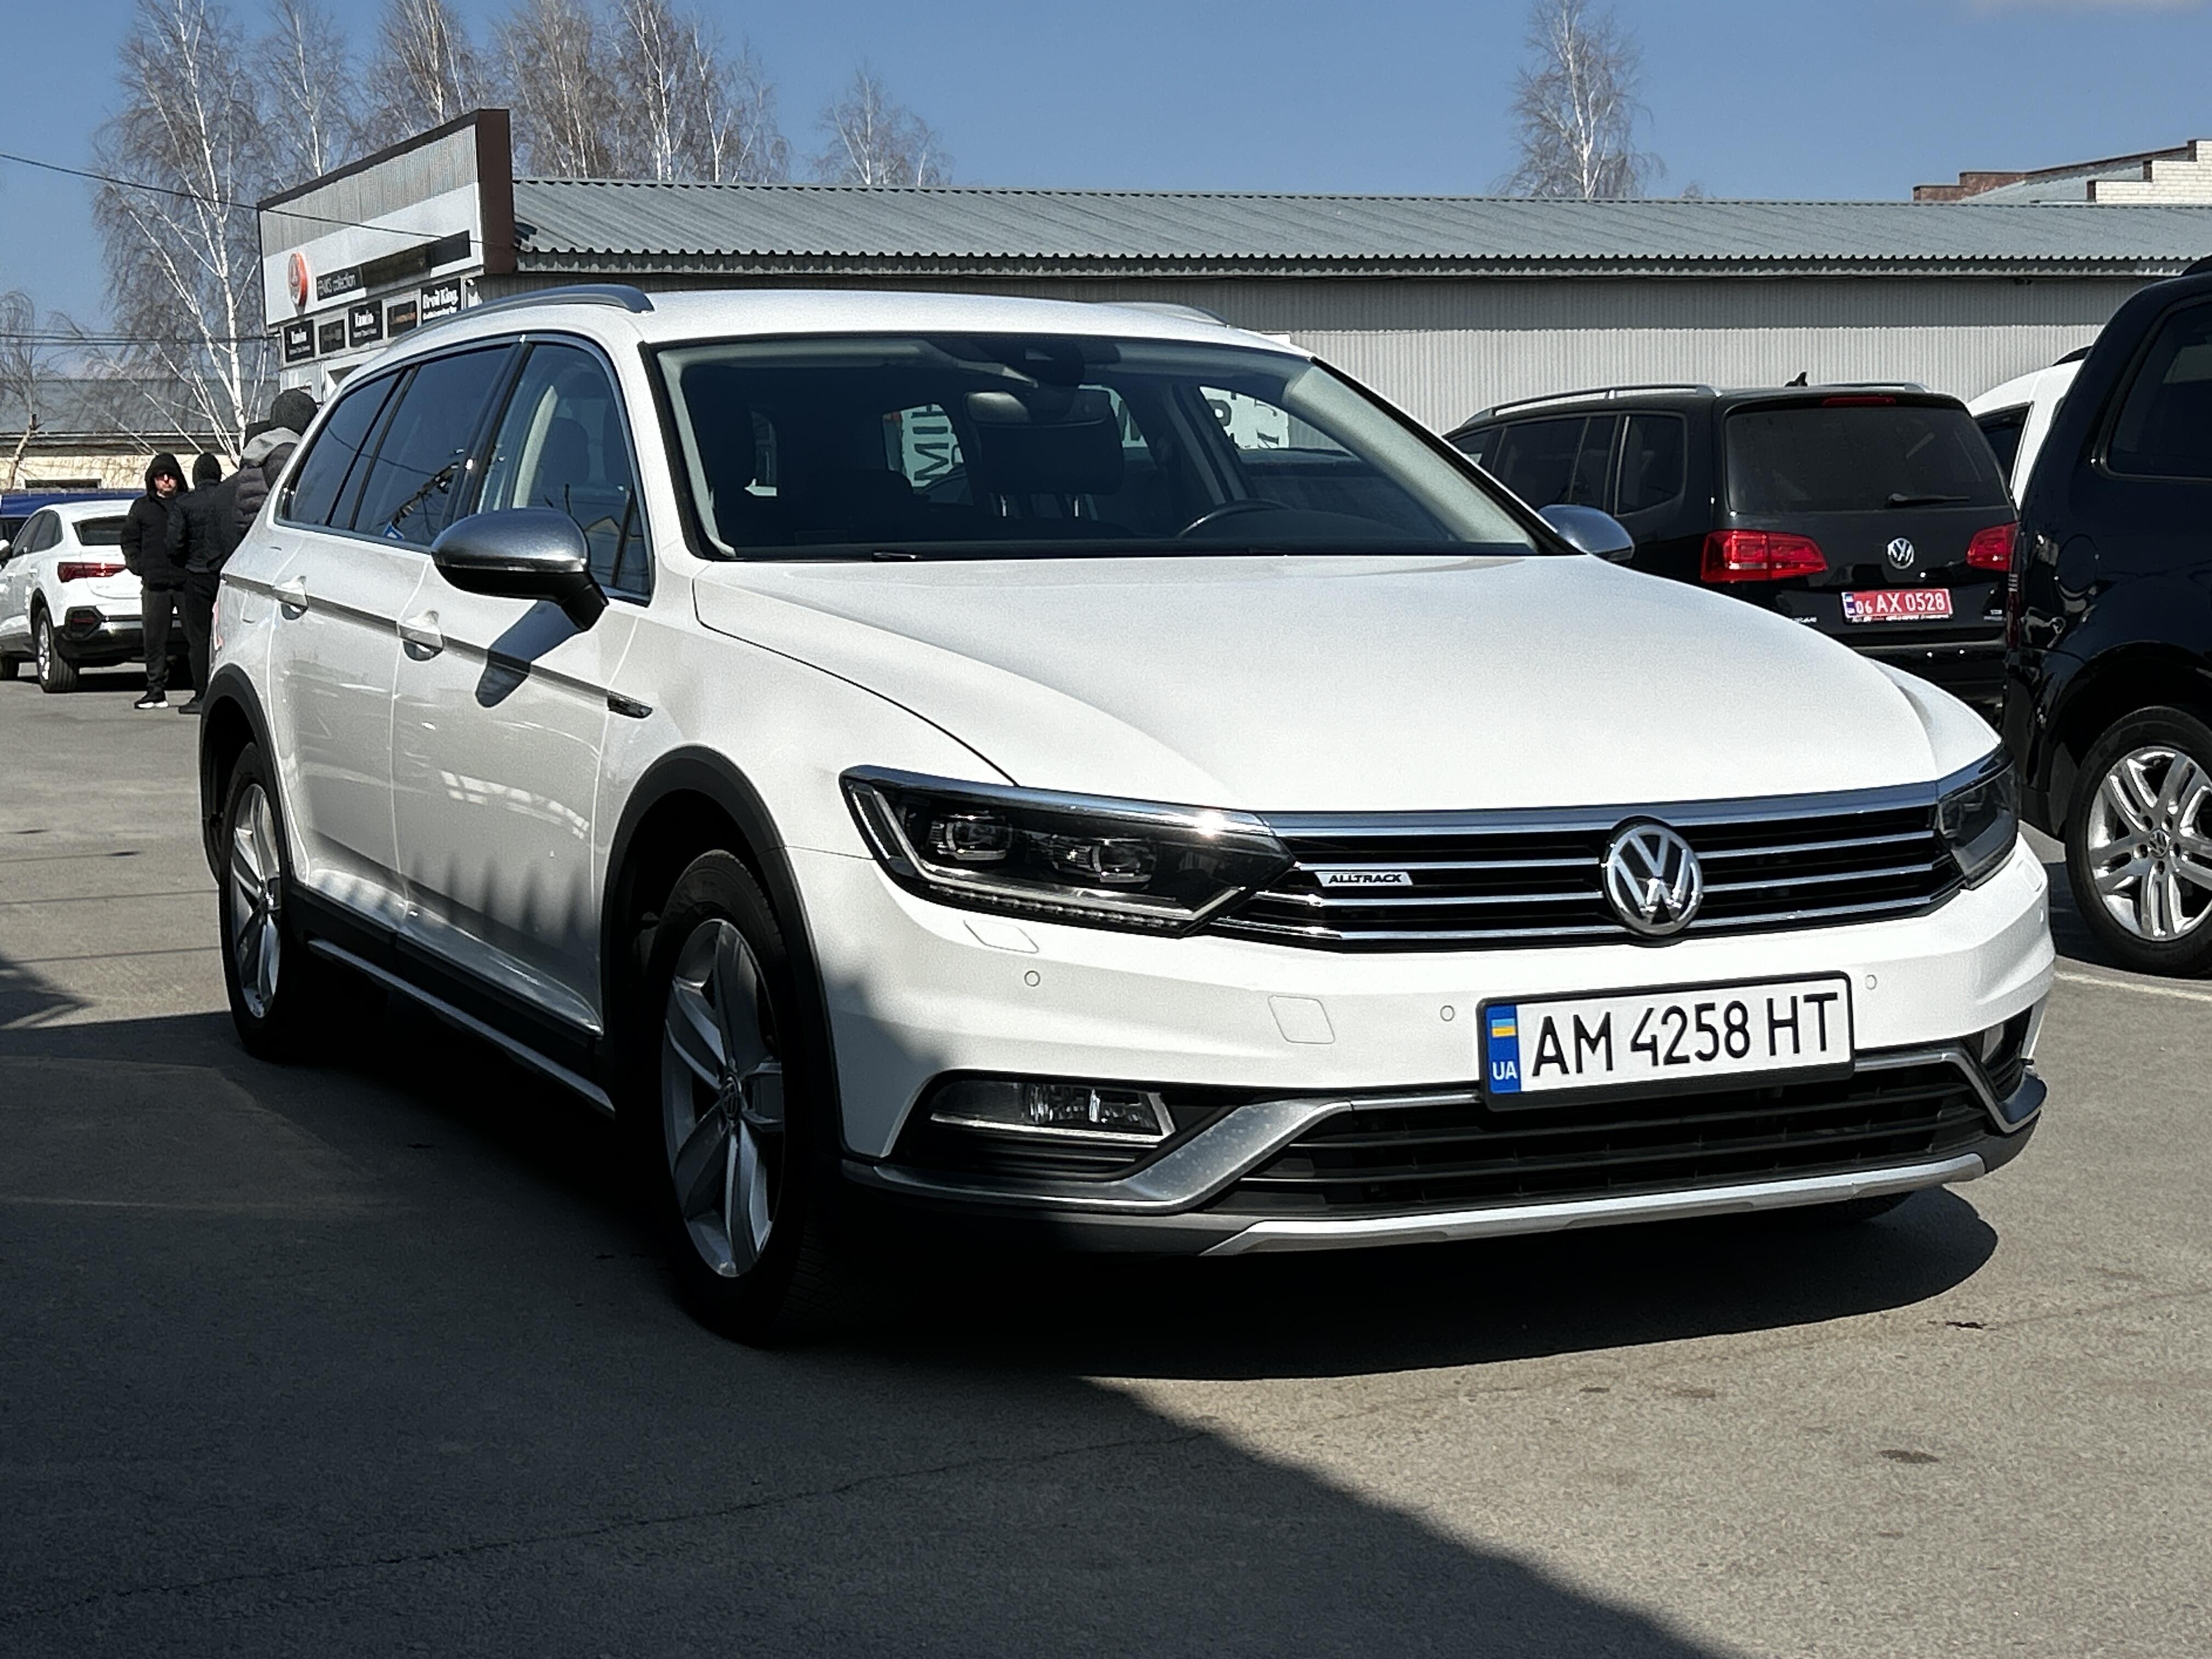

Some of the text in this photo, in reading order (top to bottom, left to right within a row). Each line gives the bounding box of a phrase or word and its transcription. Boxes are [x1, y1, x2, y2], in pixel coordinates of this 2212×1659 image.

[1855, 592, 1945, 614] 06 AX 0528
[1328, 873, 1402, 884] ALLTRACK
[1532, 992, 1838, 1077] AM 4258 HT
[1492, 1061, 1518, 1080] UA
